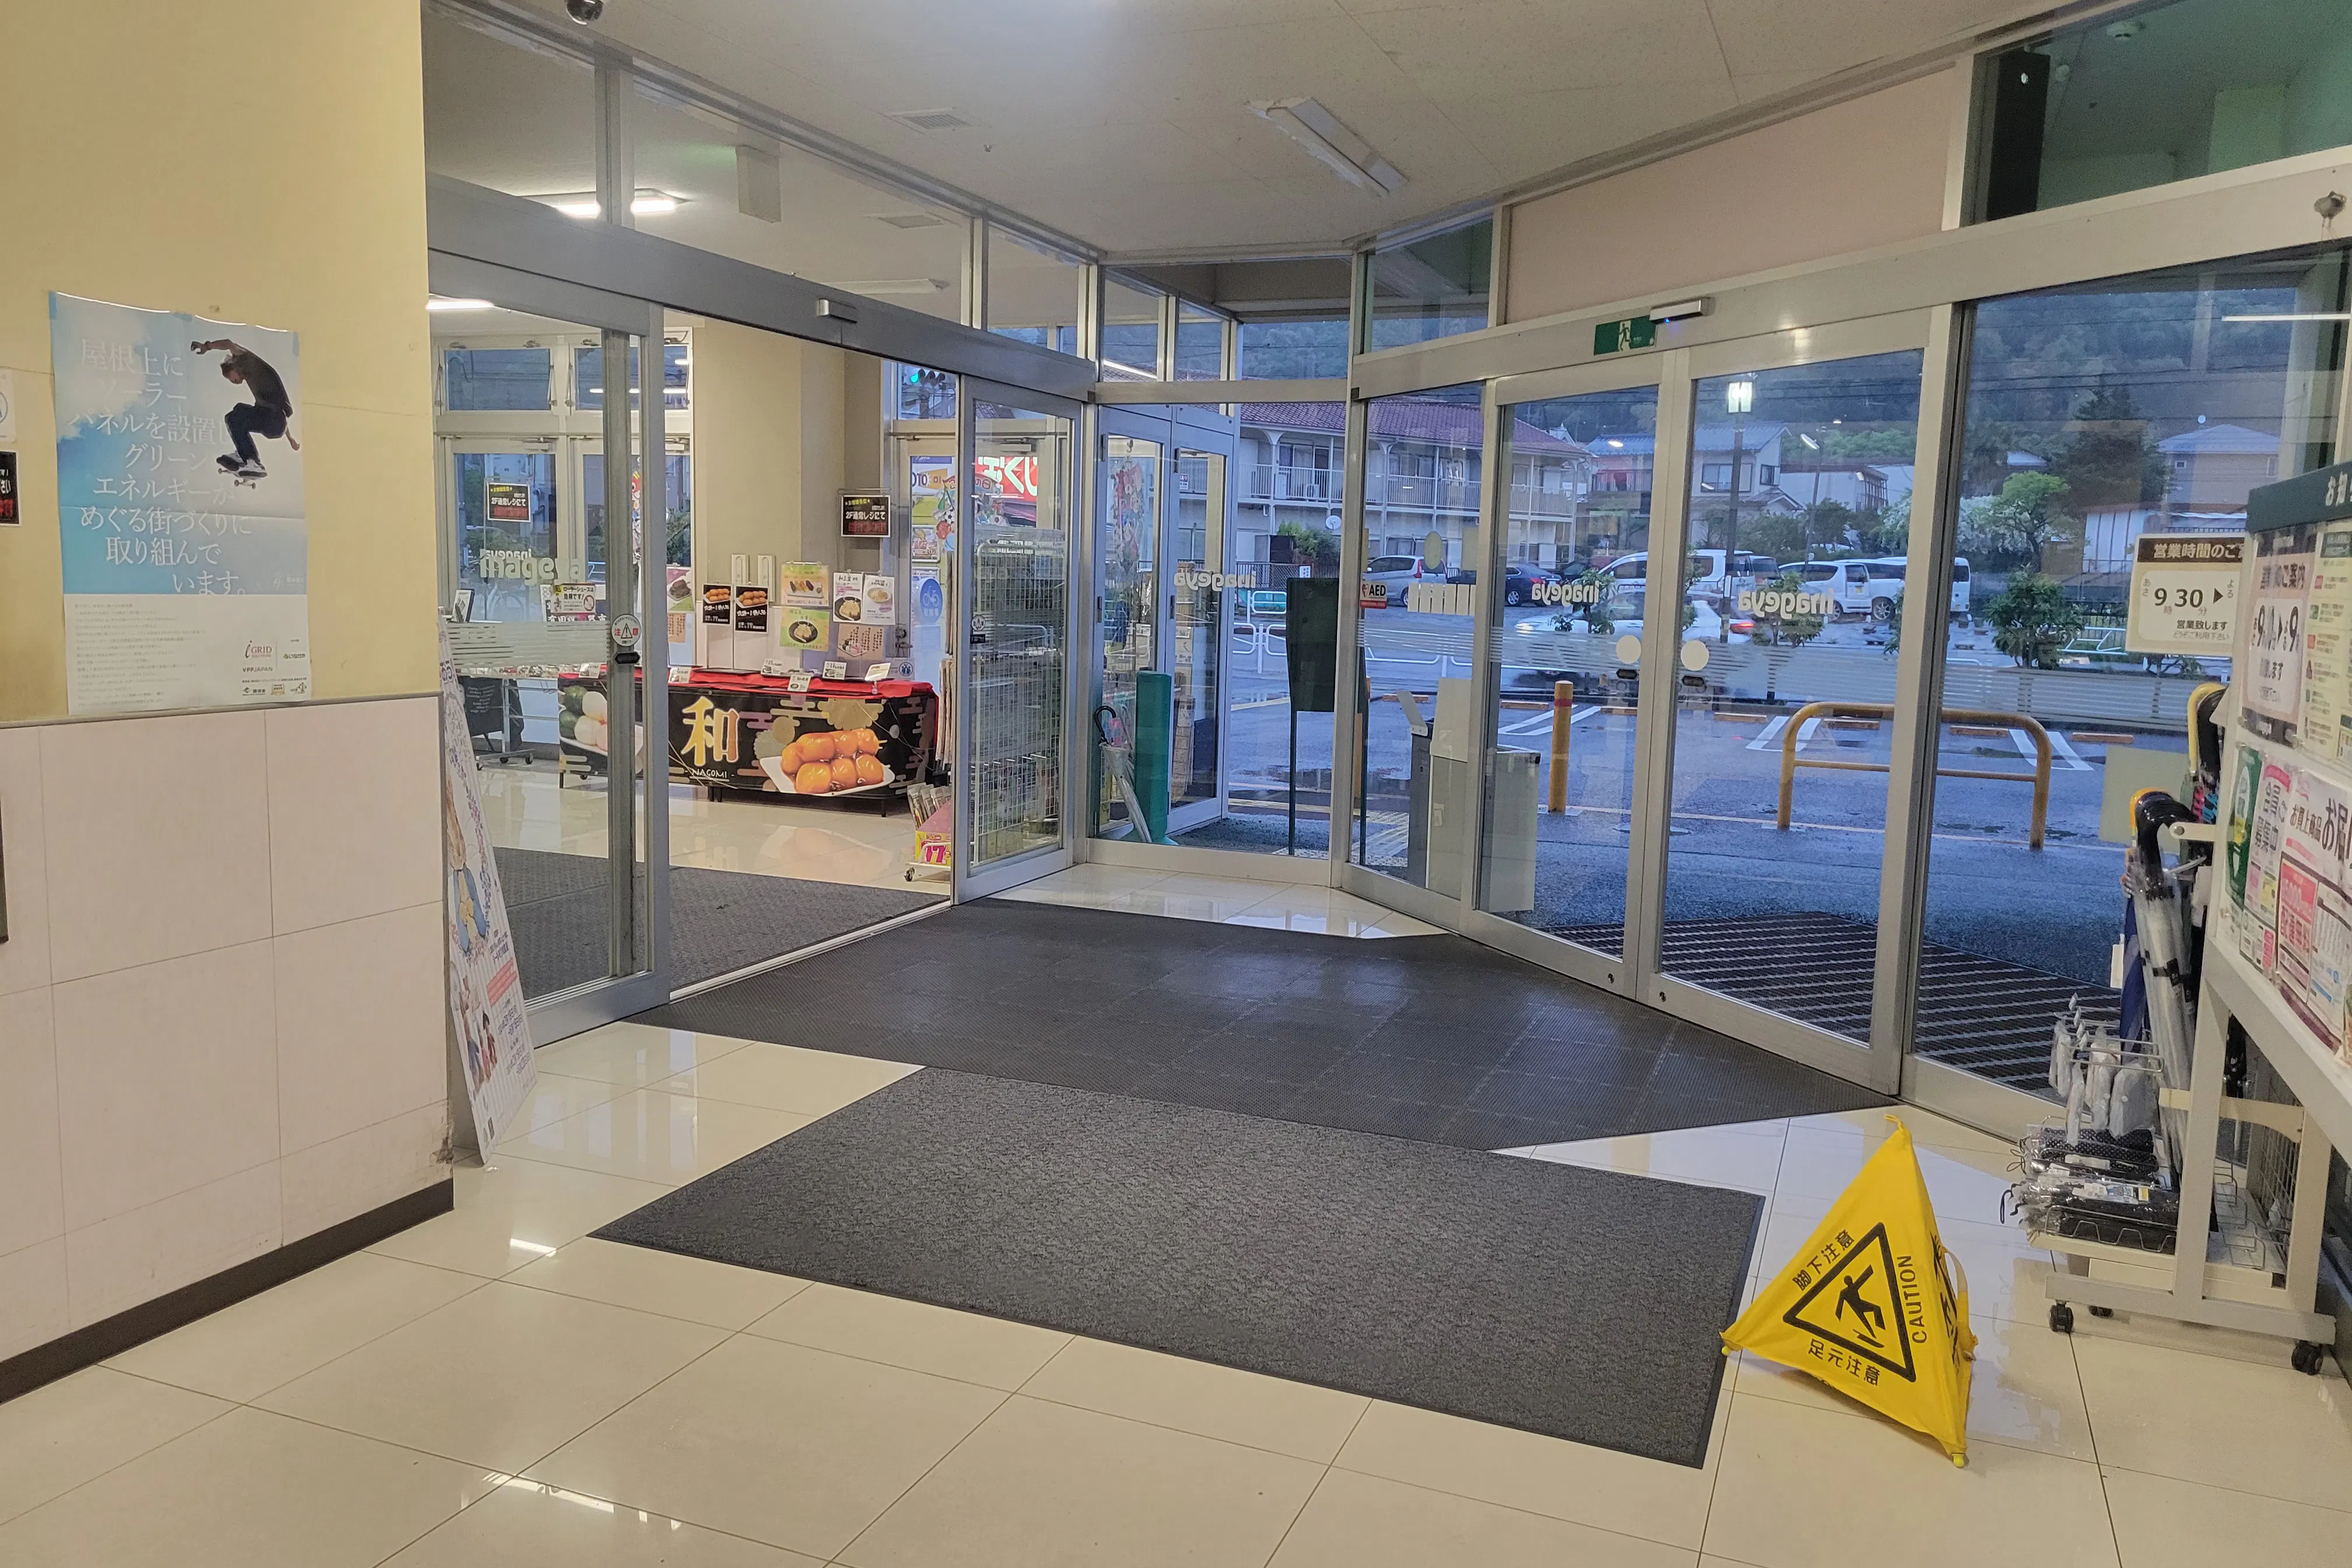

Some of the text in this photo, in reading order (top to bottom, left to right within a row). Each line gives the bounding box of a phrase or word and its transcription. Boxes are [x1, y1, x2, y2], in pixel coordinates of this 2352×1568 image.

[82, 338, 184, 376] 屋根上に
[125, 443, 208, 470] グリーン
[93, 474, 235, 505] エネルギーが
[80, 506, 252, 536] めぐる街づくりに
[105, 537, 222, 565] 取り組んで
[173, 570, 245, 594] います。
[1368, 584, 1386, 596] AED
[2142, 578, 2151, 597] あさ
[2154, 588, 2167, 606] 9
[2175, 589, 2203, 608] 30
[2227, 579, 2234, 598] よる
[2177, 620, 2228, 631] 営業致します
[681, 696, 740, 766] 和
[692, 768, 727, 779] NAGOMI
[1792, 1229, 1855, 1292] 脚下注意
[1896, 1255, 1927, 1344] CAUTION
[1808, 1338, 1880, 1387] 足元注意
